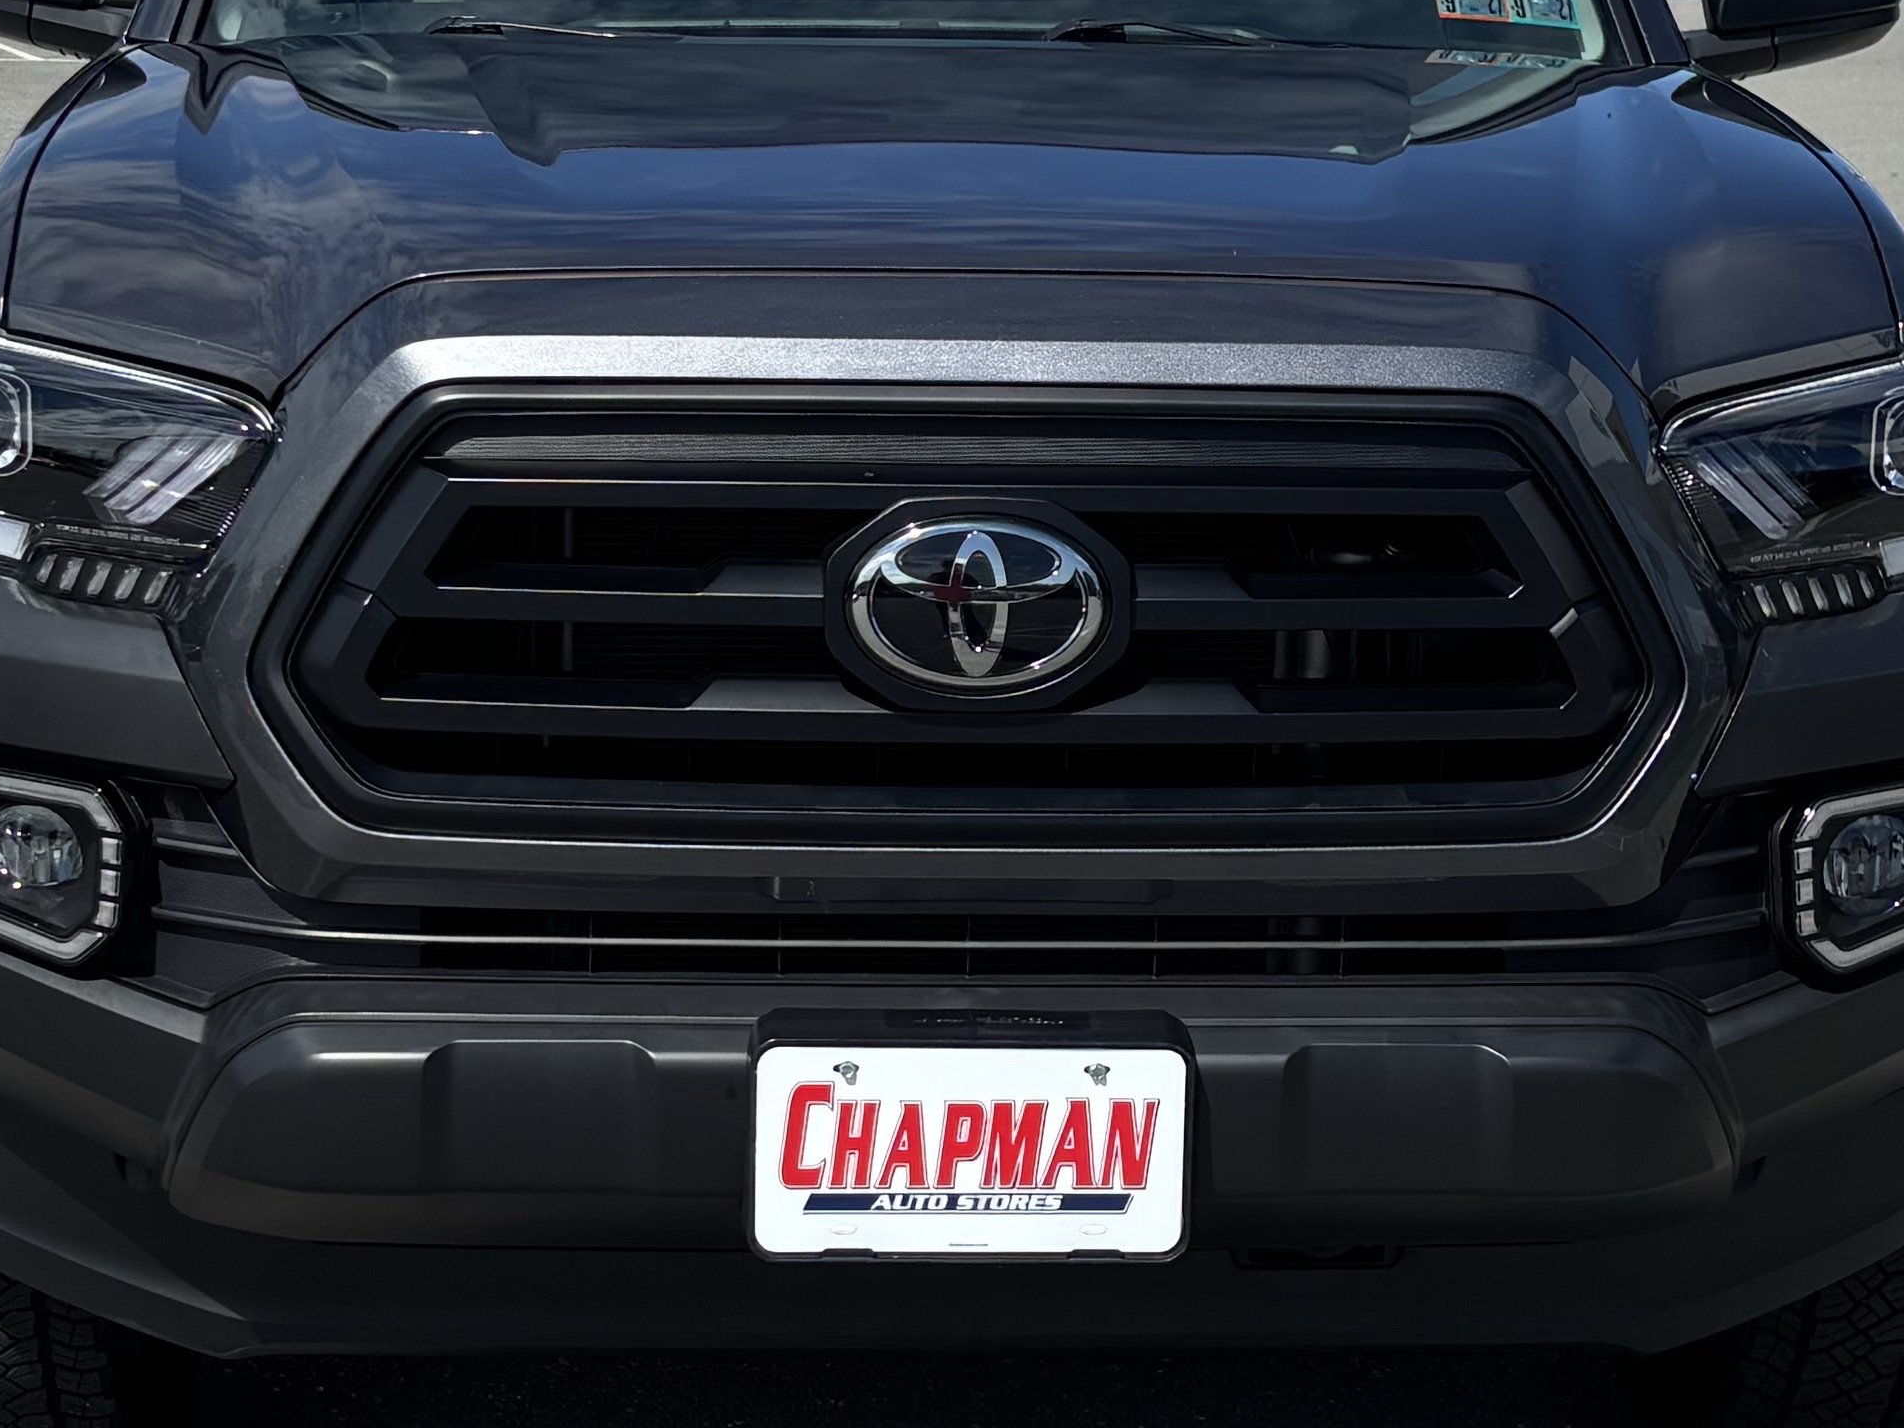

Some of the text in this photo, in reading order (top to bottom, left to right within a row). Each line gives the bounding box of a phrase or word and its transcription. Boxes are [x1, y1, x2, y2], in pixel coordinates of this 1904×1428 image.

[778, 1080, 1161, 1191] CHAPMAN
[870, 1193, 1064, 1211] AUTO STORES
